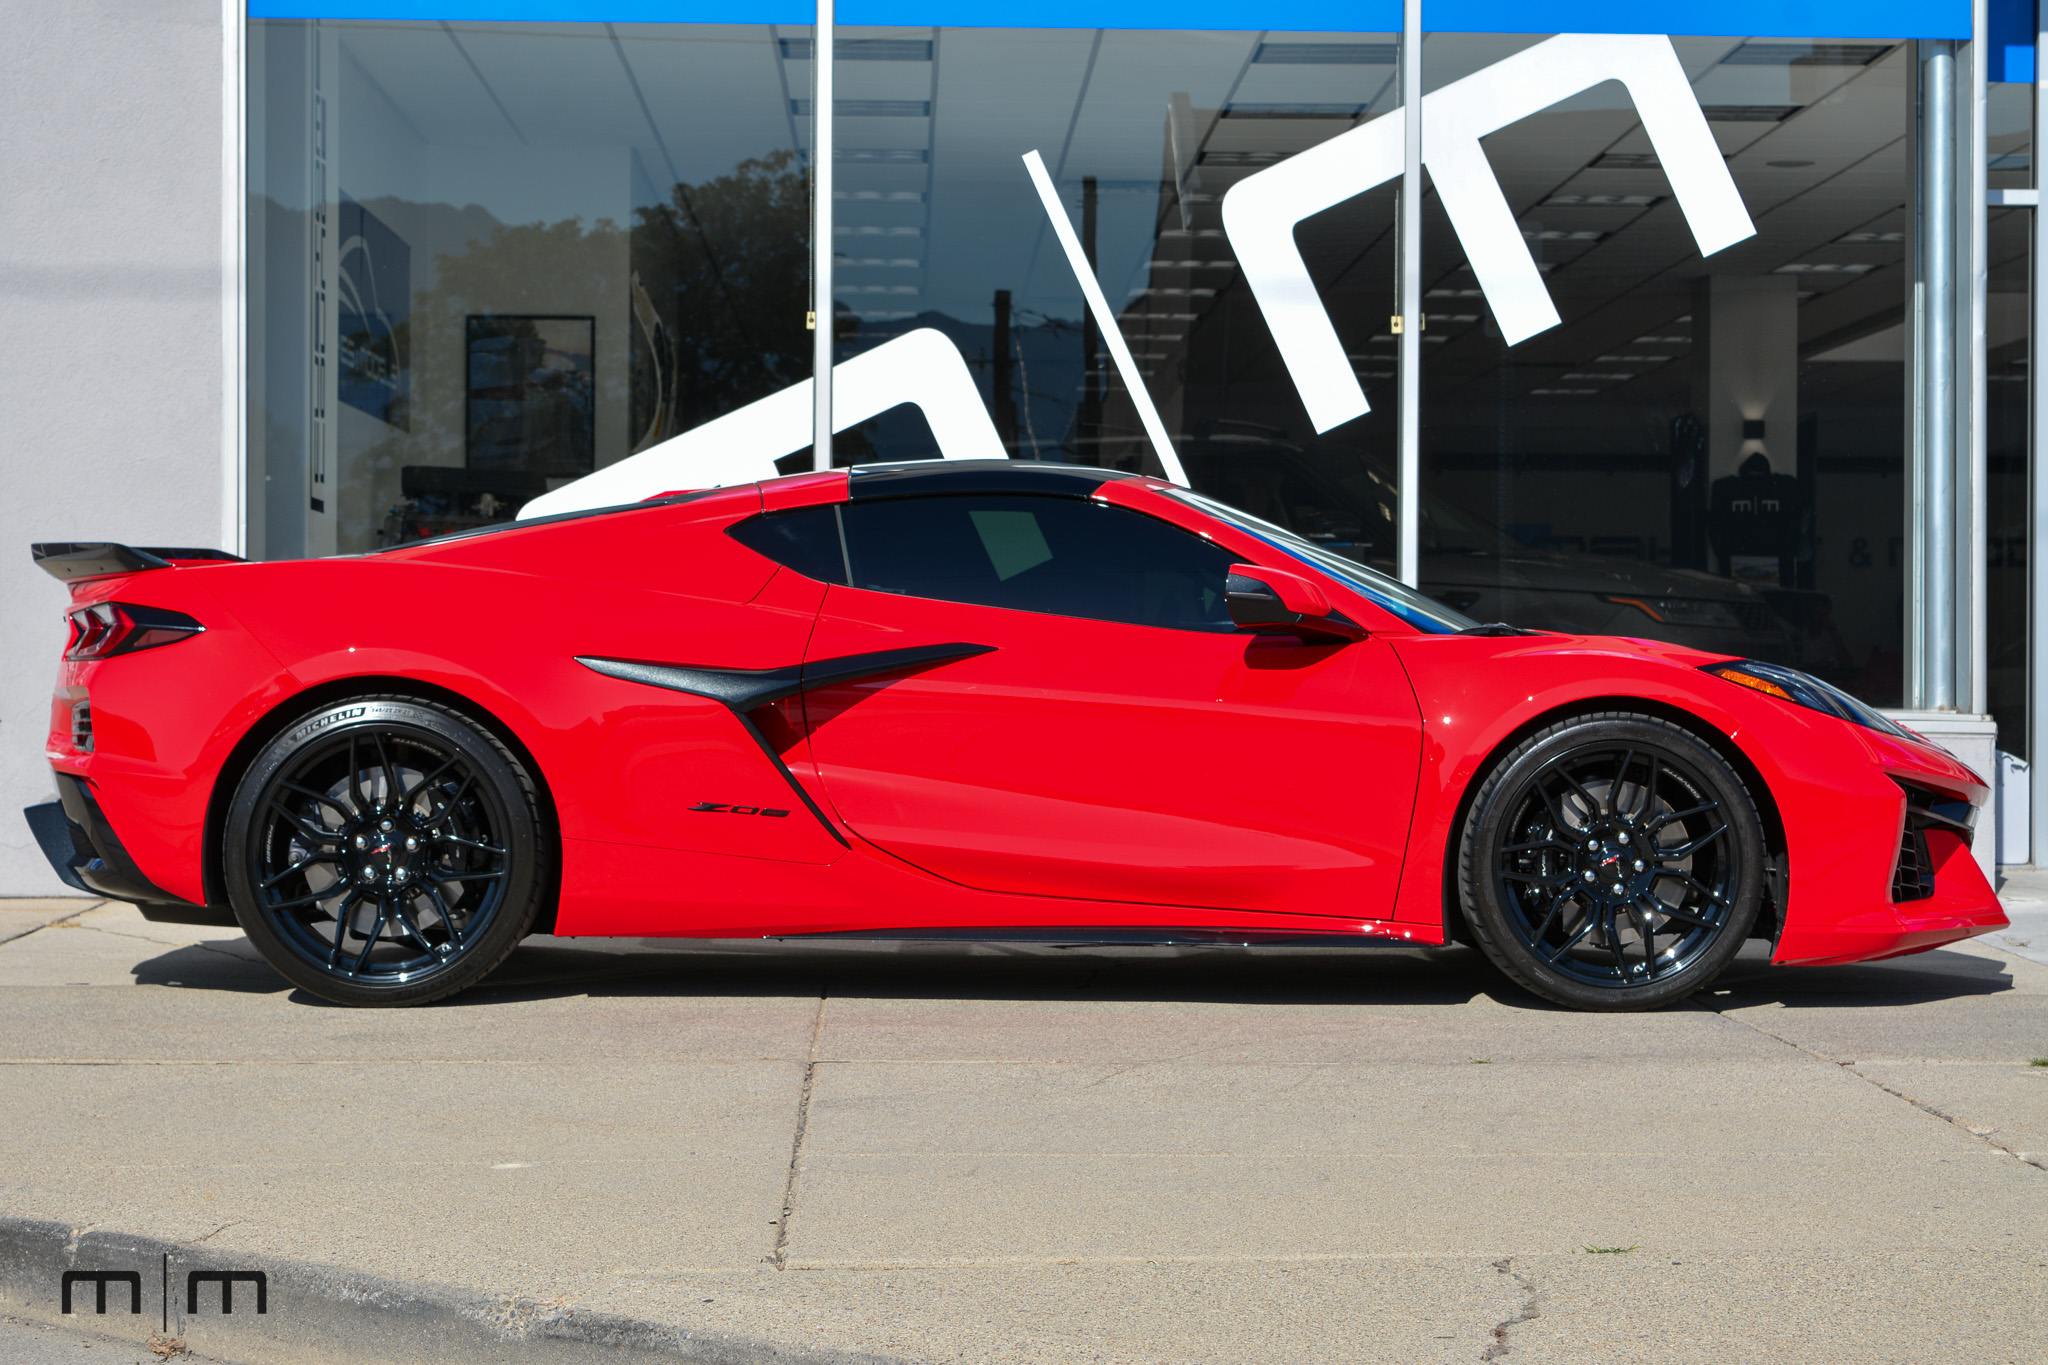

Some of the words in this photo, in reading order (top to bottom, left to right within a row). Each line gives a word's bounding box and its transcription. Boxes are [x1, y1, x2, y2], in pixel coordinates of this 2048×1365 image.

[295, 707, 364, 740] MICHELIN
[1662, 767, 1701, 799] CORVETTE
[686, 802, 792, 818] Z06
